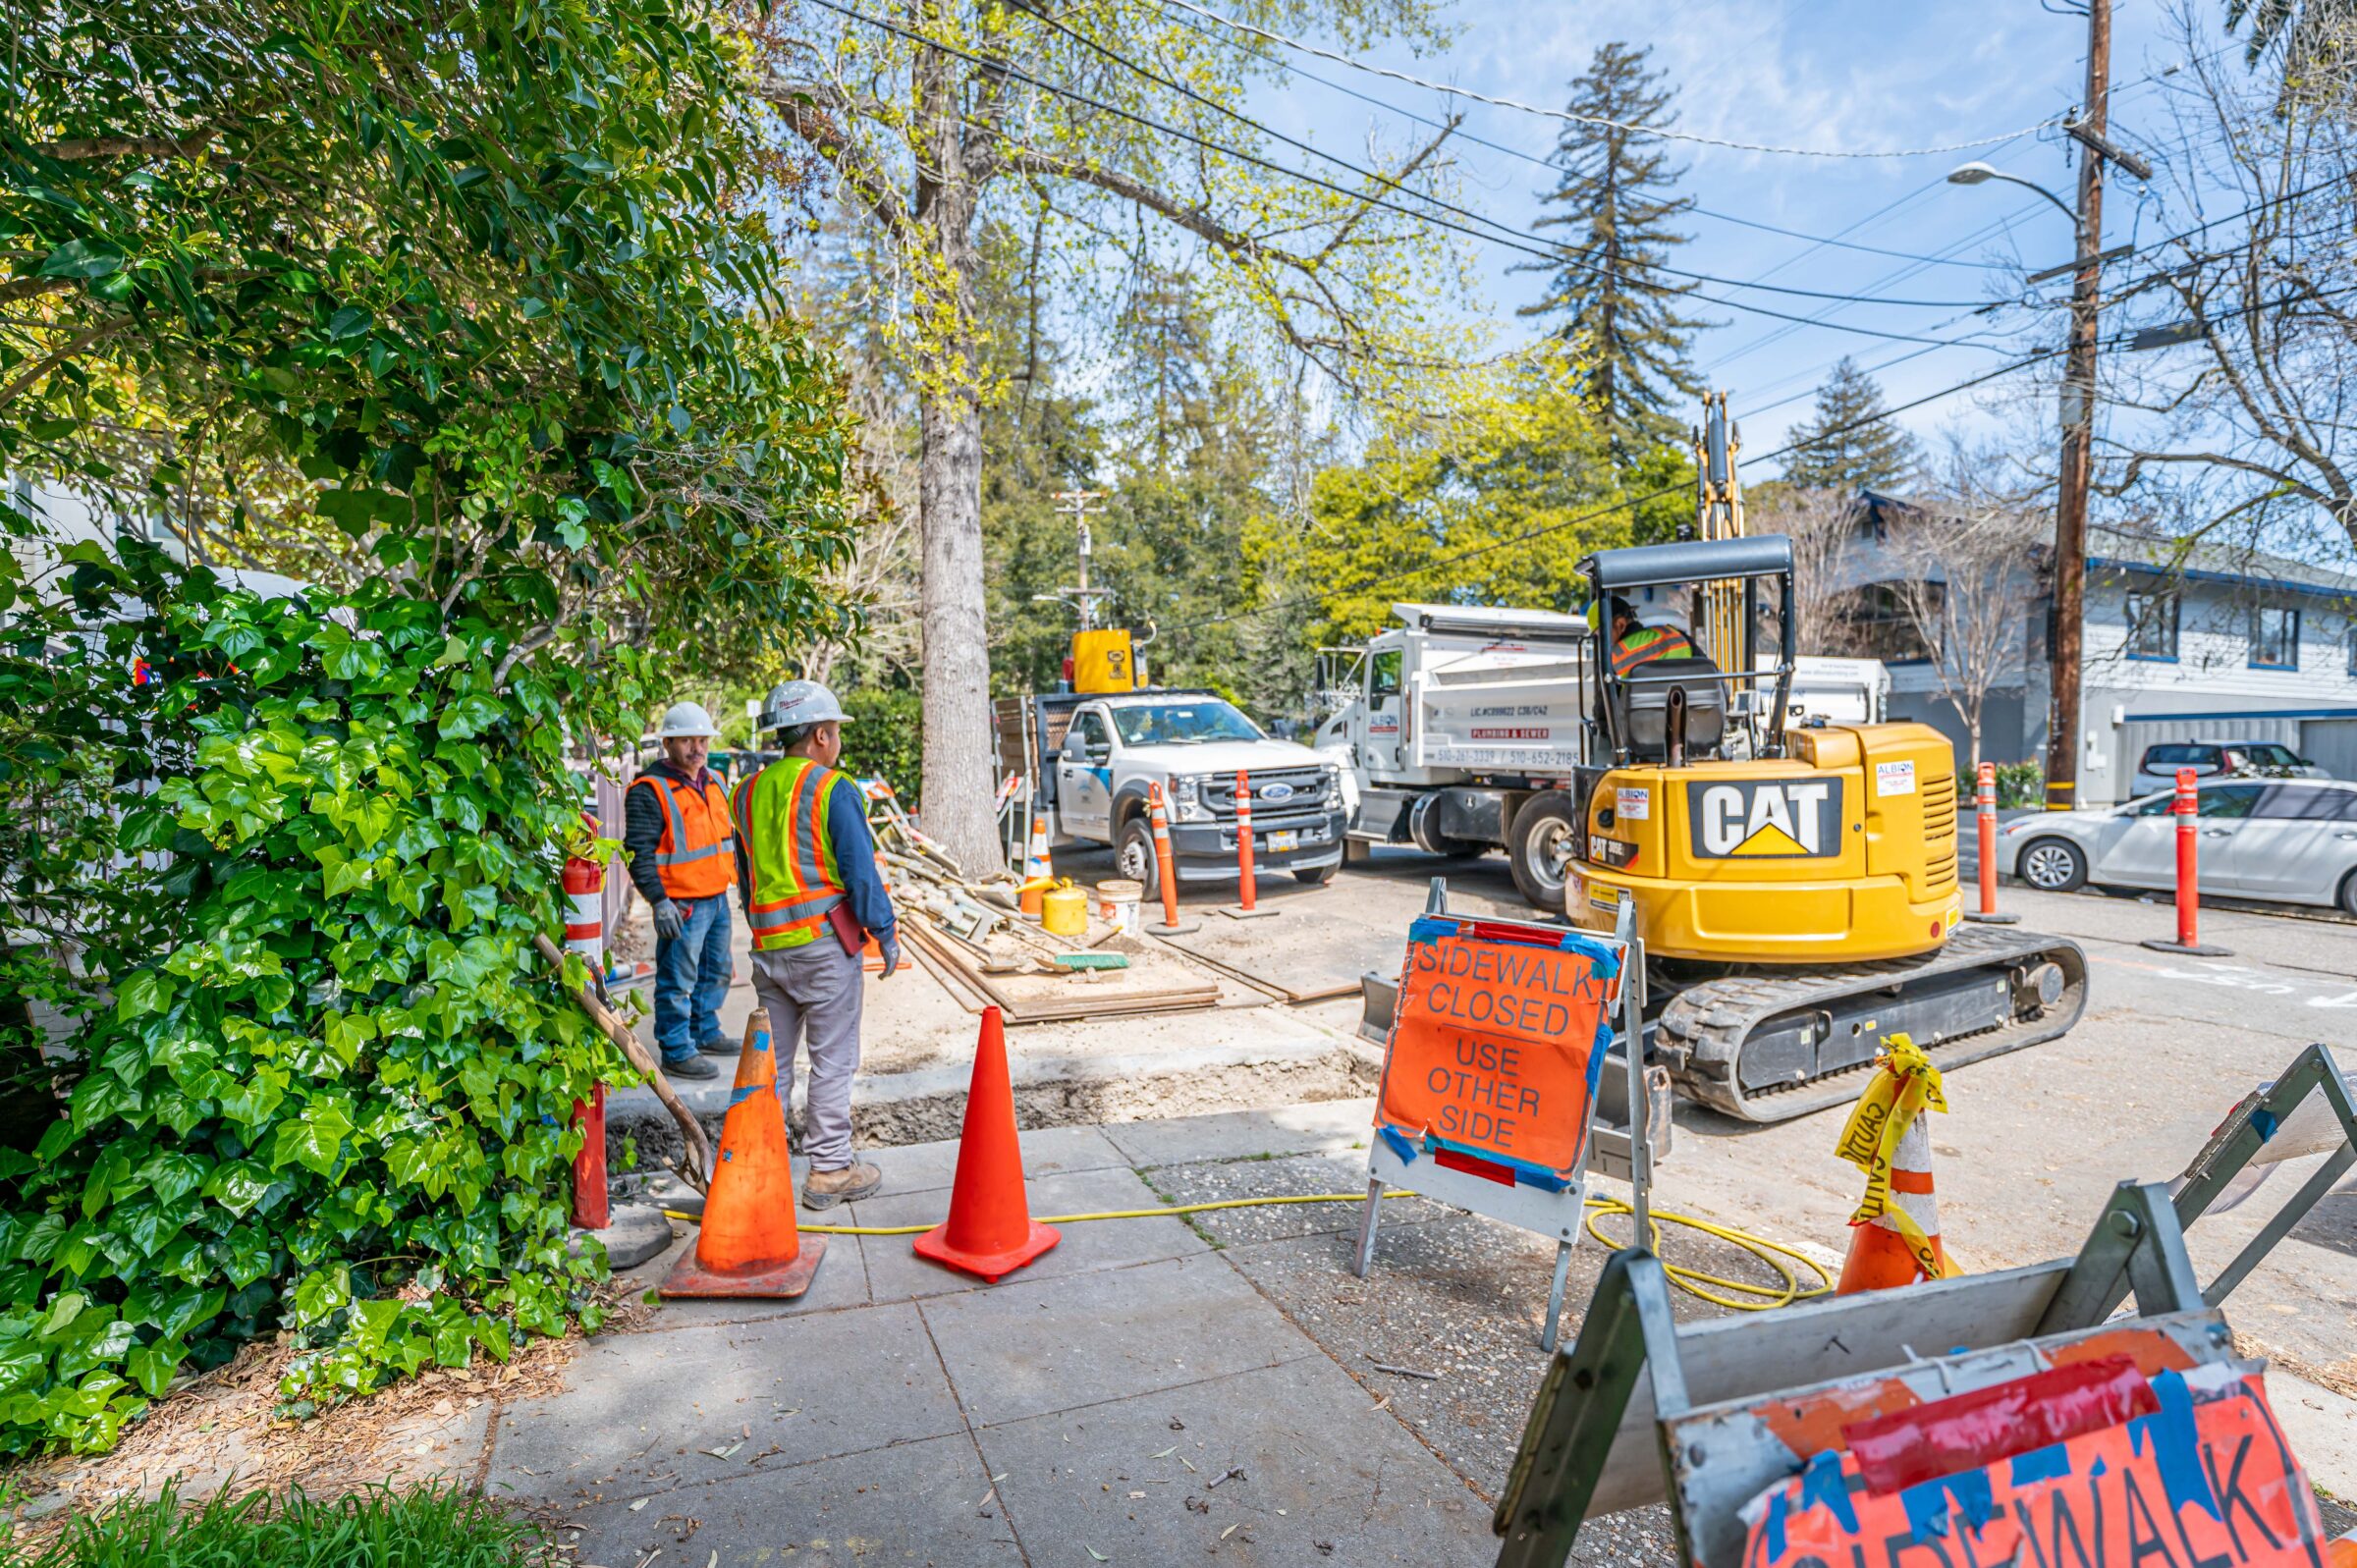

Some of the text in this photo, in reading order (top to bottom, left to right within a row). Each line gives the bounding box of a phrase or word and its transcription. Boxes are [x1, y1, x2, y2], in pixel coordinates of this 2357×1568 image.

[1509, 750, 1580, 765] 510-652-2185
[1878, 763, 1913, 774] ALBION
[1617, 789, 1648, 799] ALBION
[1702, 784, 1829, 855] CAT
[1591, 835, 1608, 861] CAT
[1417, 945, 1594, 999] SIDEWALK
[1428, 983, 1569, 1036] CLOSED
[1456, 1038, 1520, 1077] USE
[1428, 1067, 1541, 1117] OTHER
[1439, 1105, 1516, 1148] SIDE
[1793, 1432, 2284, 1568] WALK
